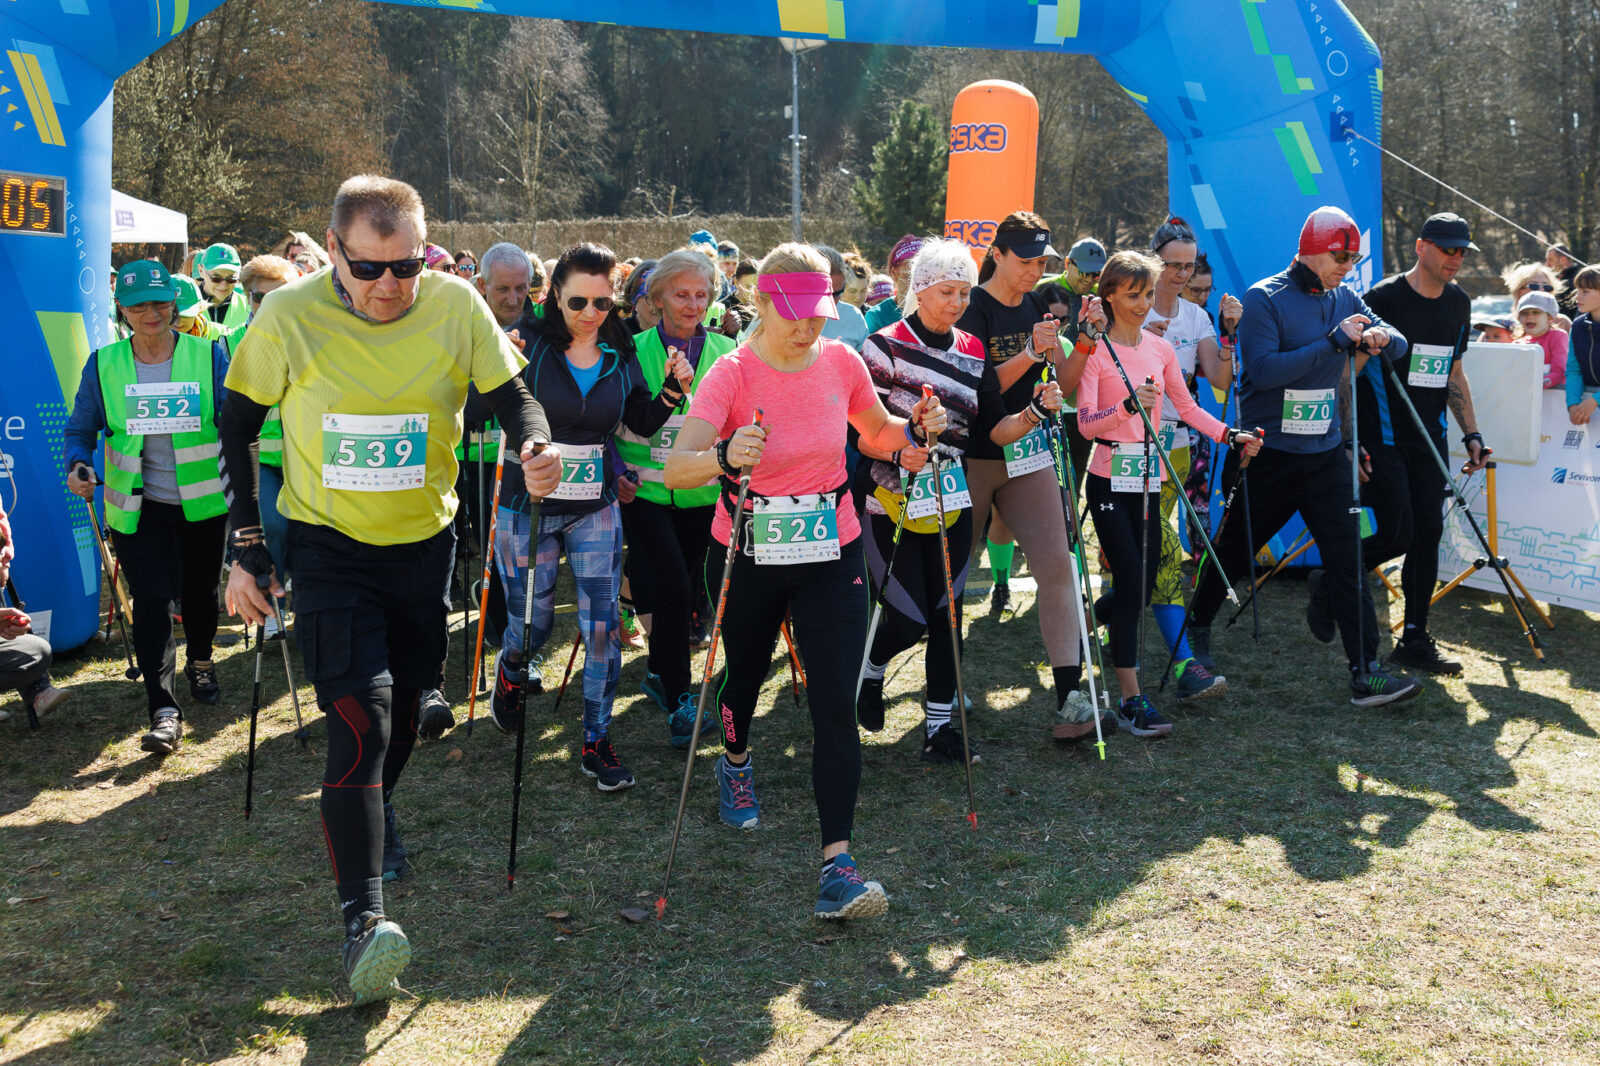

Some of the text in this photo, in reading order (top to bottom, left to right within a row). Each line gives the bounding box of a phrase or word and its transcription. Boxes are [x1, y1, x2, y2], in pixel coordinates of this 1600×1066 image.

[1418, 358, 1449, 374] 593
[136, 399, 190, 418] 552
[1291, 404, 1330, 420] 570
[0, 416, 25, 440] e
[660, 431, 673, 448] 5
[1014, 435, 1044, 460] 522
[1159, 434, 1167, 448] 3
[336, 439, 413, 468] 539
[566, 463, 596, 483] 73
[1120, 459, 1155, 477] 594
[912, 474, 957, 499] 600
[766, 516, 828, 543] 526
[703, 578, 730, 683] FLASH CARBON
[722, 703, 737, 742] ADIZERO
